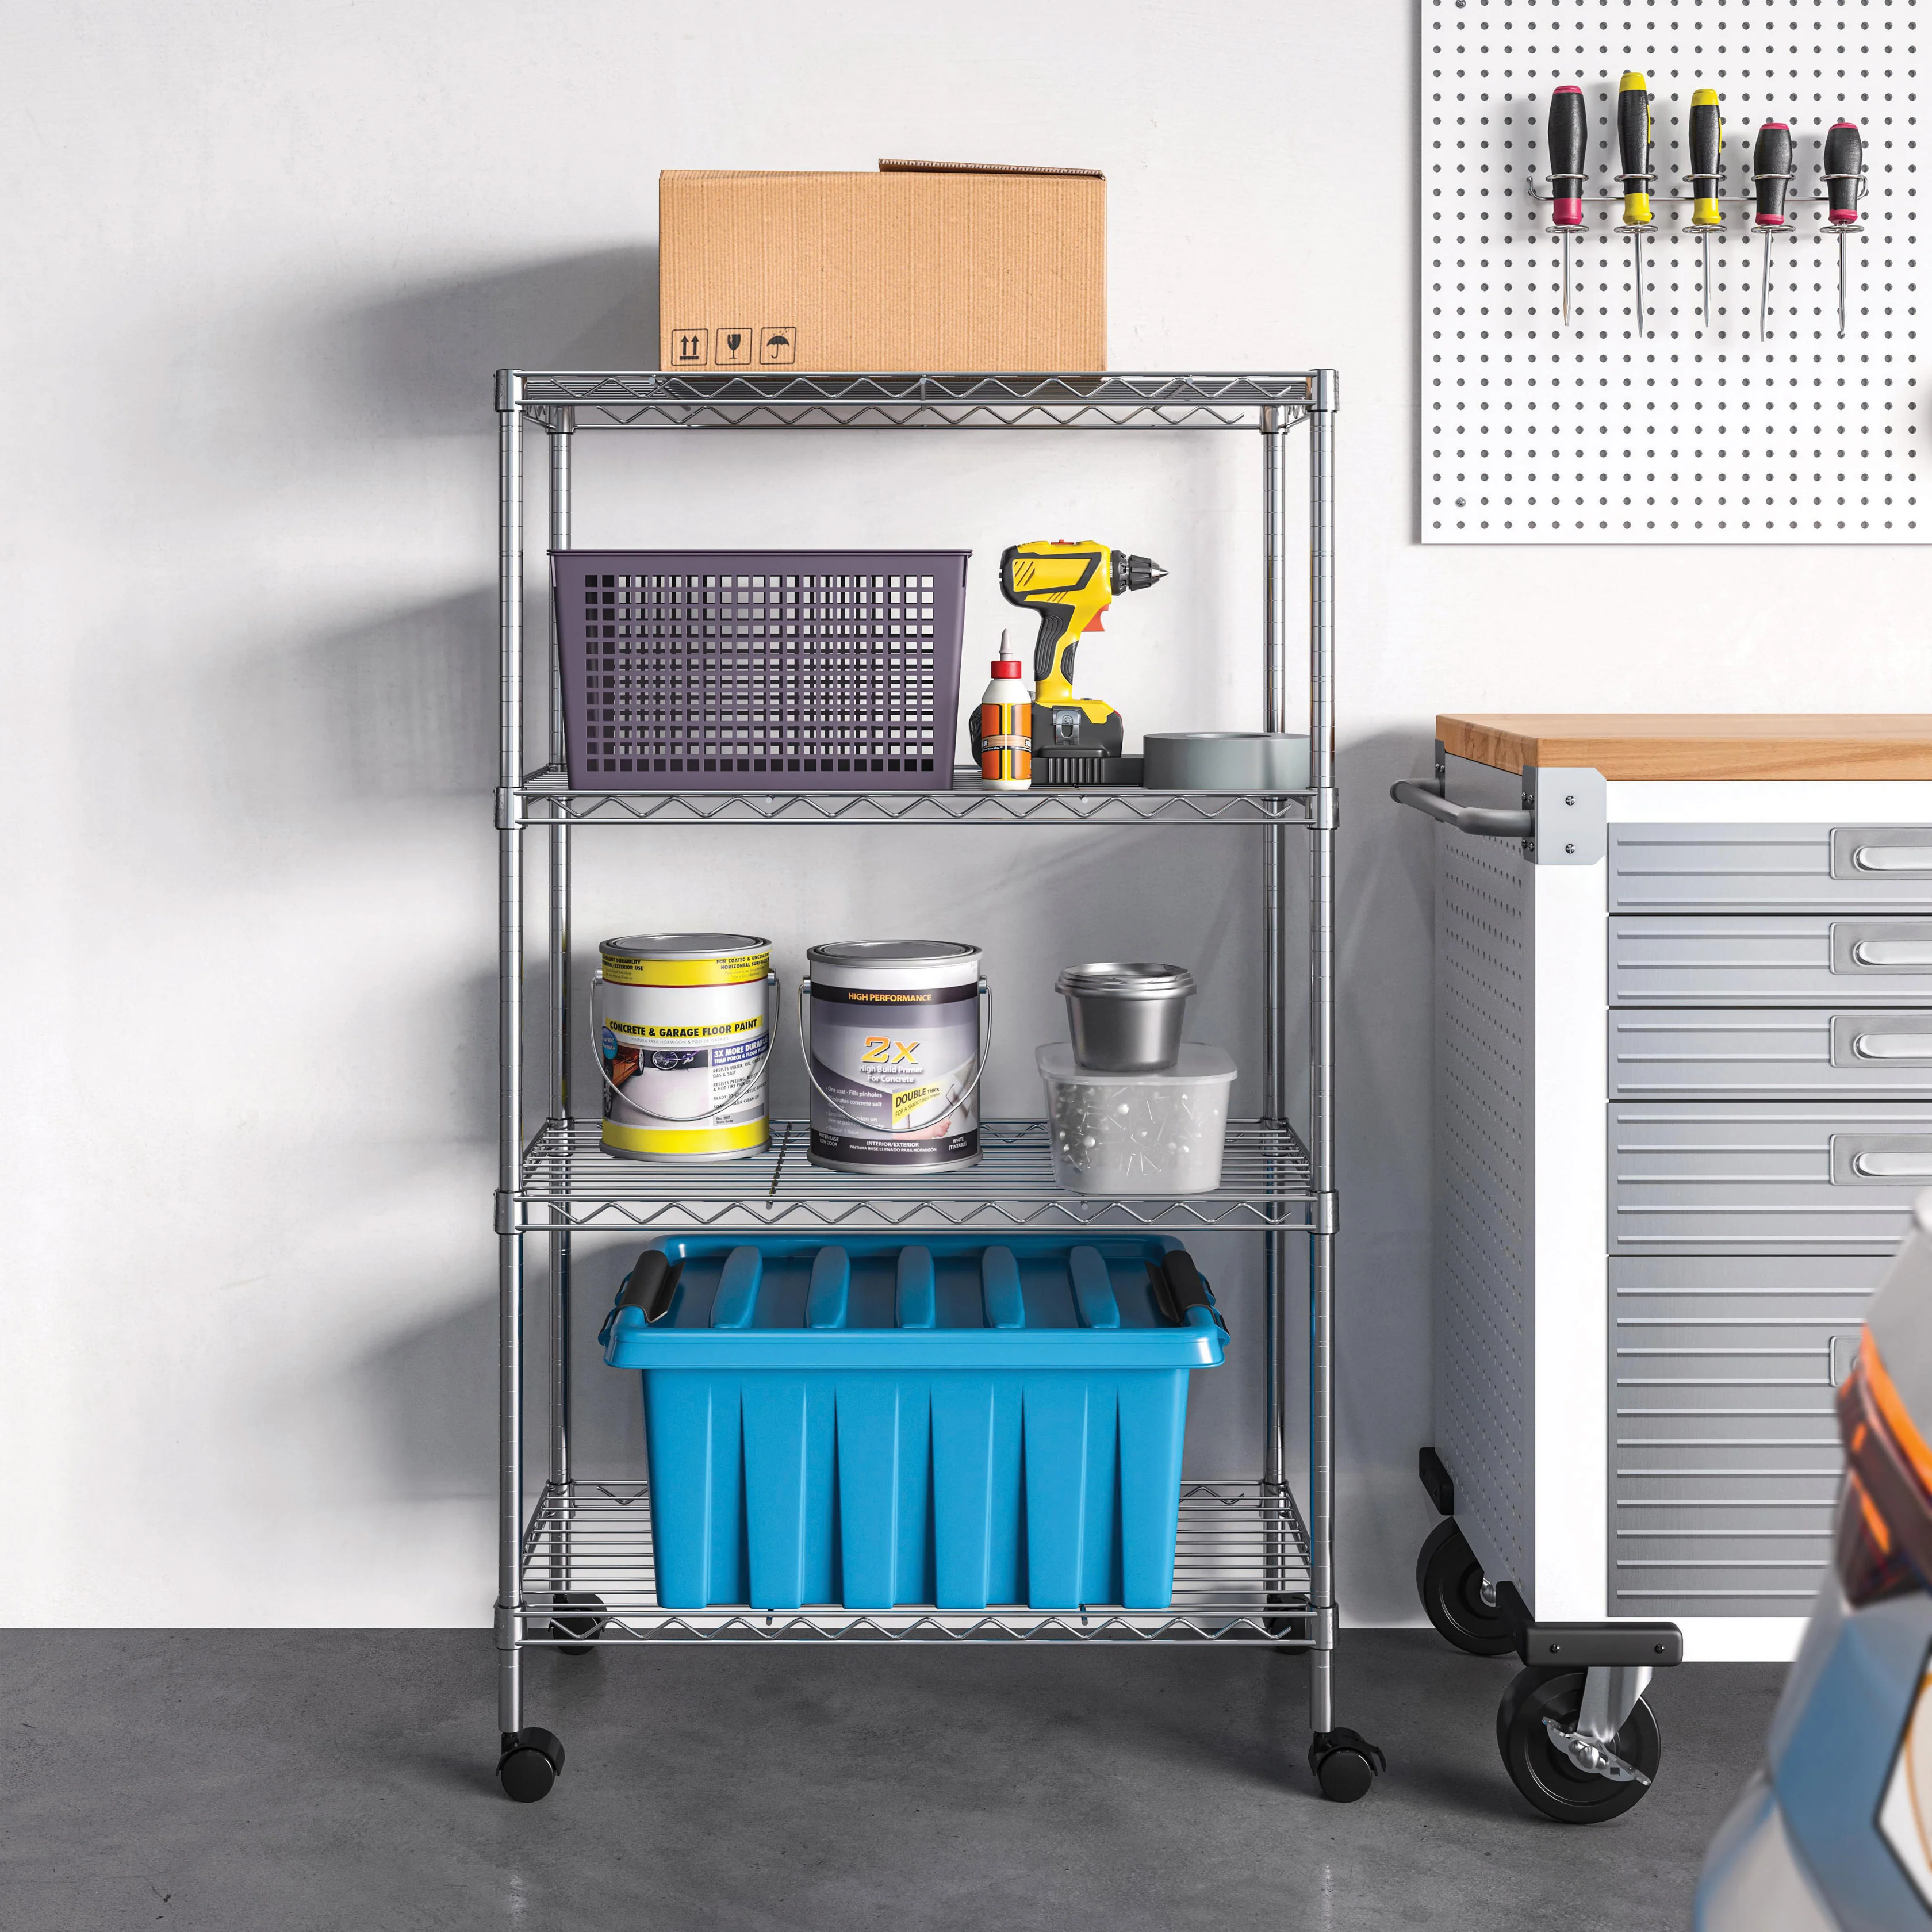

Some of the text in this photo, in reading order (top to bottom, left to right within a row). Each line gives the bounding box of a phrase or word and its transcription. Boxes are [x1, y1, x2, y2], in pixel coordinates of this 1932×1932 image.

[849, 992, 868, 1000] HIGH
[610, 1019, 757, 1037] CONCRETE & GARAGE FLOOR PAINT
[725, 1046, 743, 1056] MORE
[745, 1035, 768, 1051] DURABLE
[859, 1065, 876, 1073] High
[744, 1094, 759, 1103] CLEAN-UP
[896, 1088, 926, 1107] DOUBLE
[908, 1097, 929, 1110] SMOOTHER
[819, 1132, 839, 1142] WATER-BASE
[949, 1141, 967, 1150] (TINTABLE)
